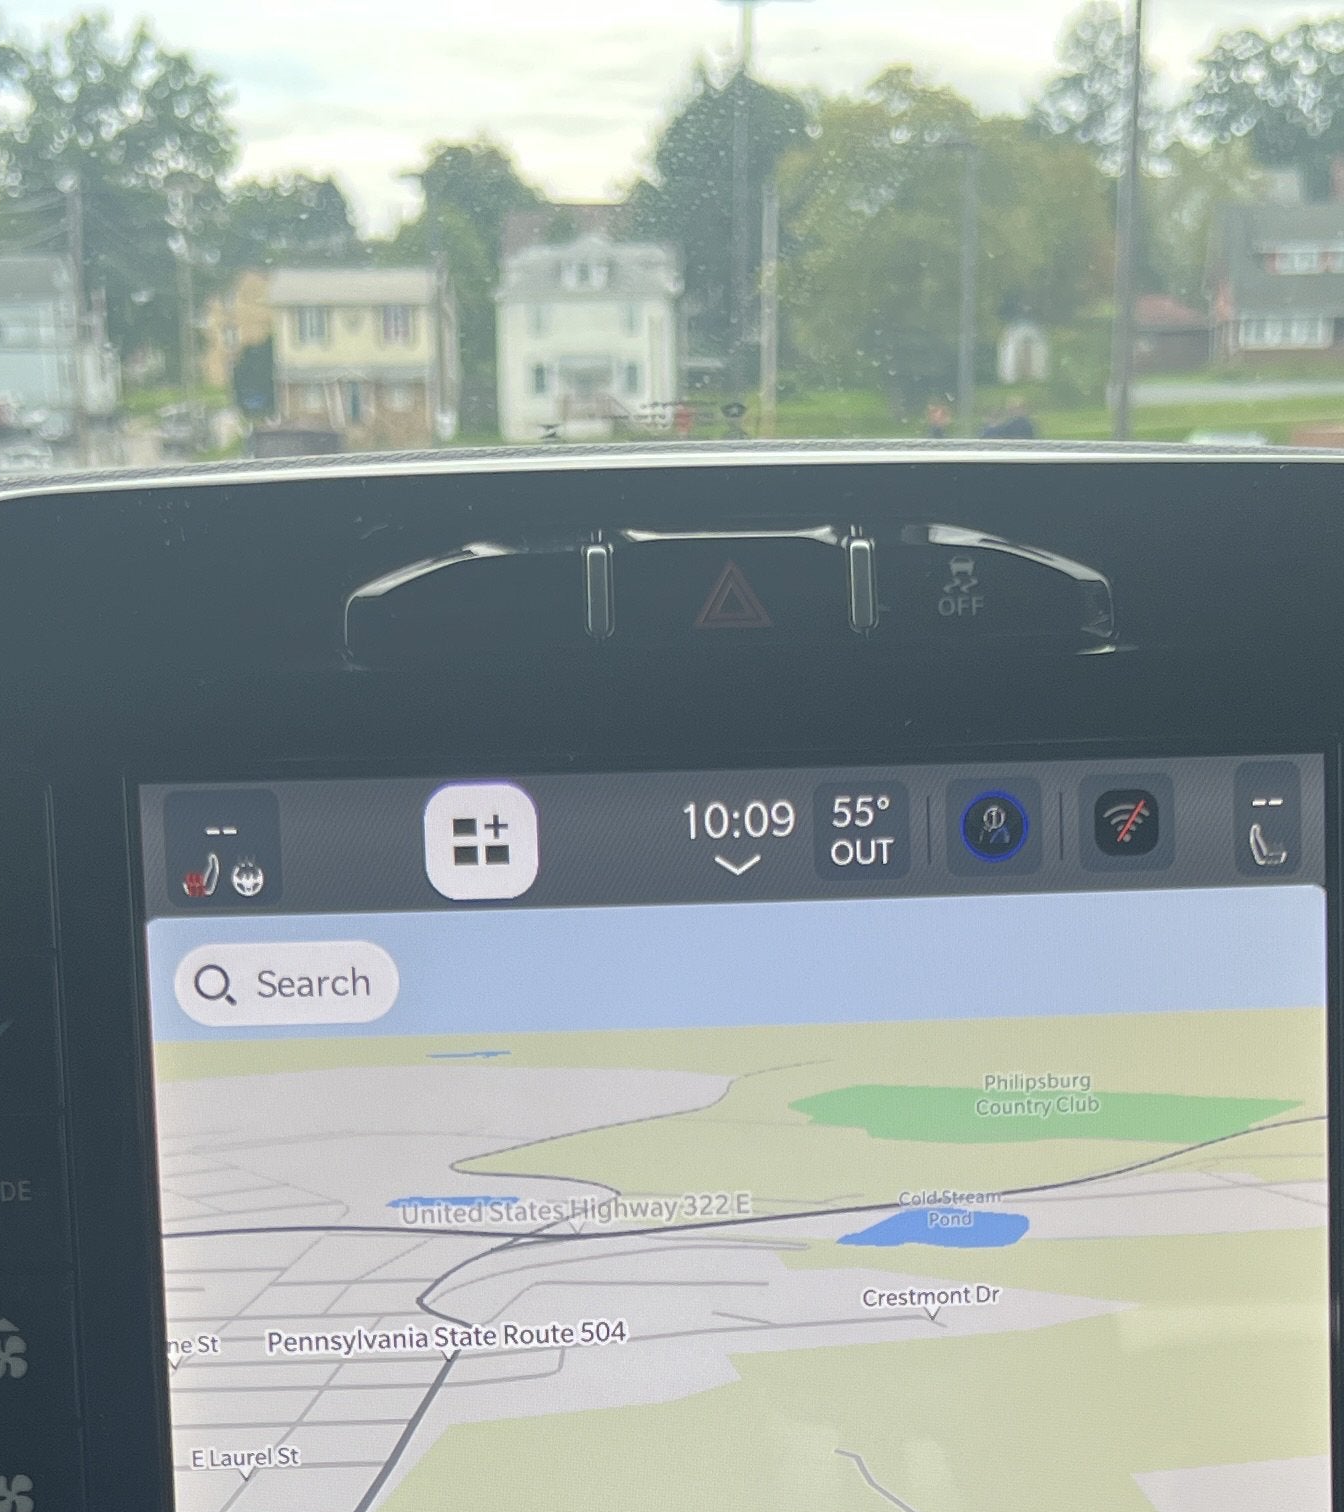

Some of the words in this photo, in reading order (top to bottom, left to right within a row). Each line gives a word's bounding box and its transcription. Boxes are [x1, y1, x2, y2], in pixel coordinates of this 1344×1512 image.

[938, 596, 984, 616] OFF
[684, 800, 796, 840] 10:09
[832, 796, 890, 828] 55°
[831, 837, 894, 866] OUT
[257, 967, 371, 998] Search
[985, 1073, 1091, 1092] Philipsburg
[976, 1100, 1052, 1116] Country
[1057, 1097, 1099, 1112] Club
[899, 1192, 935, 1206] Cold
[943, 1190, 1001, 1205] Stream
[402, 1204, 483, 1224] United
[490, 1201, 563, 1222] States
[570, 1199, 678, 1222] Highway
[684, 1196, 728, 1216] 322
[737, 1194, 750, 1214] E
[928, 1213, 972, 1226] Pond
[863, 1287, 971, 1307] Crestmont
[976, 1286, 999, 1303] Dr
[198, 1336, 219, 1352] St
[268, 1328, 428, 1356] Pennsylvania
[435, 1327, 497, 1347] State
[504, 1324, 574, 1344] Route
[581, 1322, 627, 1342] 504
[192, 1450, 204, 1467] E
[210, 1448, 271, 1466] Laurel
[278, 1448, 298, 1464] St
